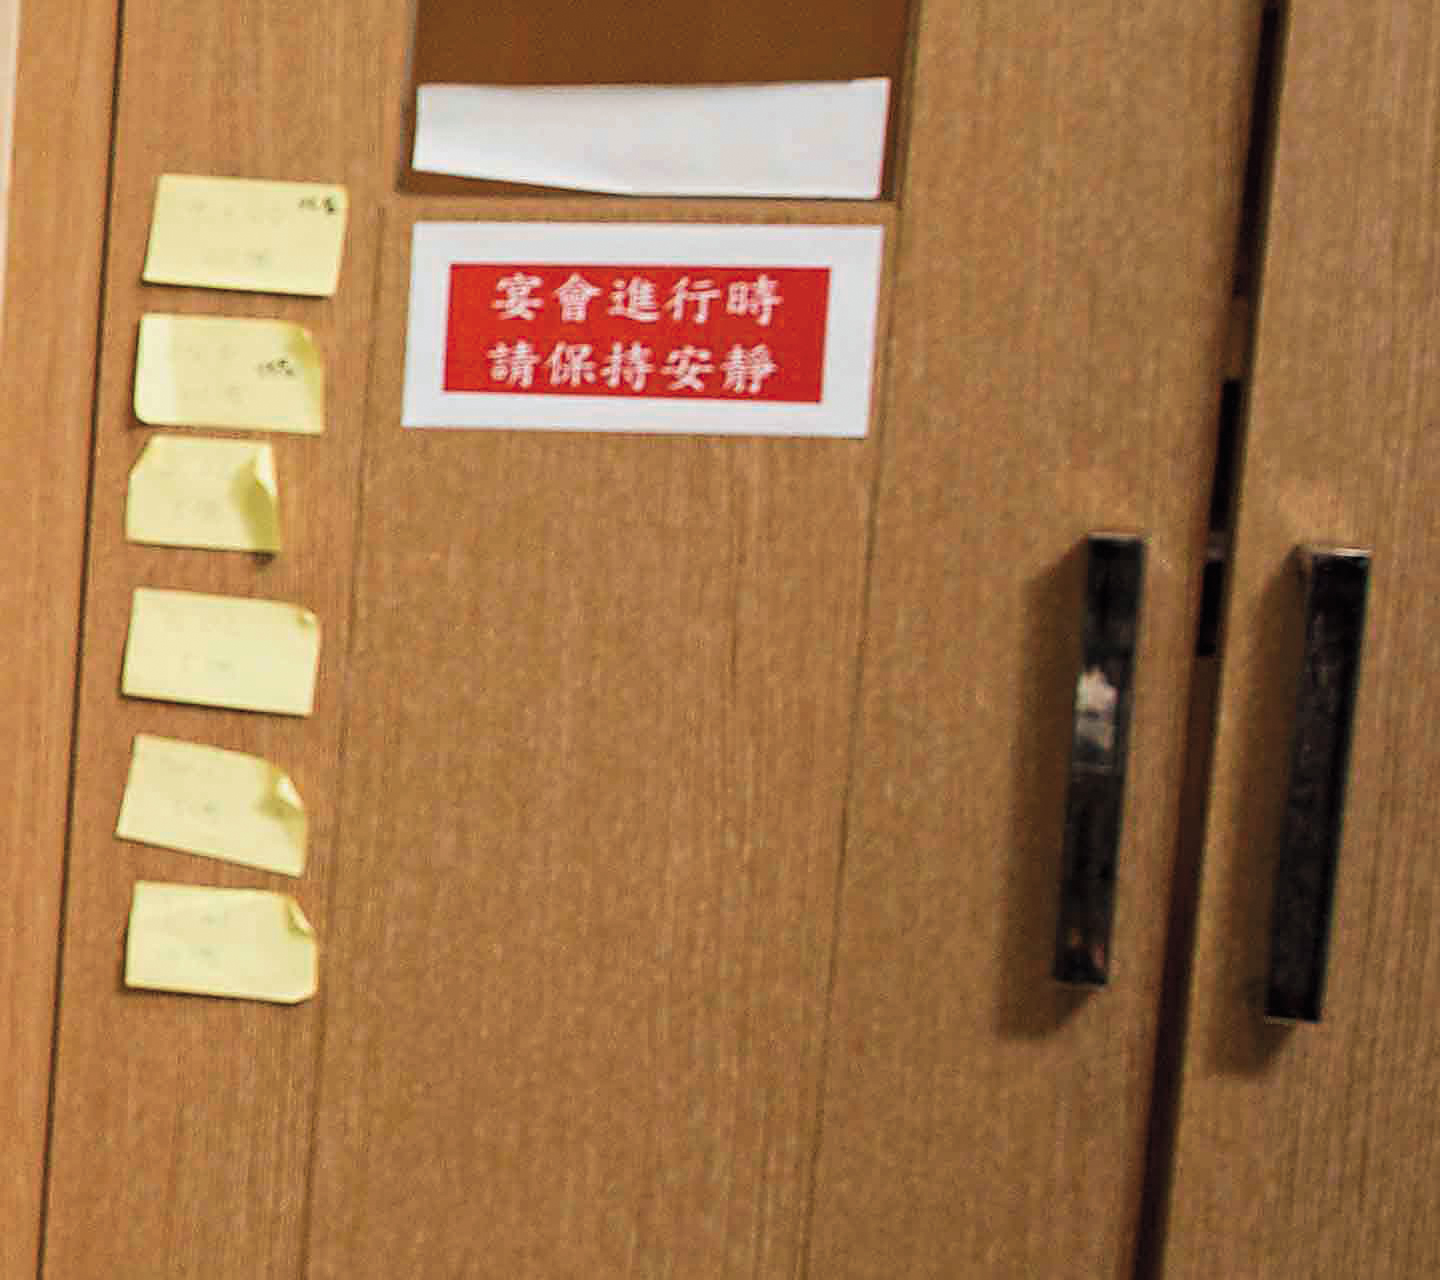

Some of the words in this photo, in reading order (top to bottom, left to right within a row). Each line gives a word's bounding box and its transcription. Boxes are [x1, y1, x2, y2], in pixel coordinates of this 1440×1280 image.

[491, 272, 783, 327] 宴會進行時
[486, 339, 778, 394] 請保持安靜
